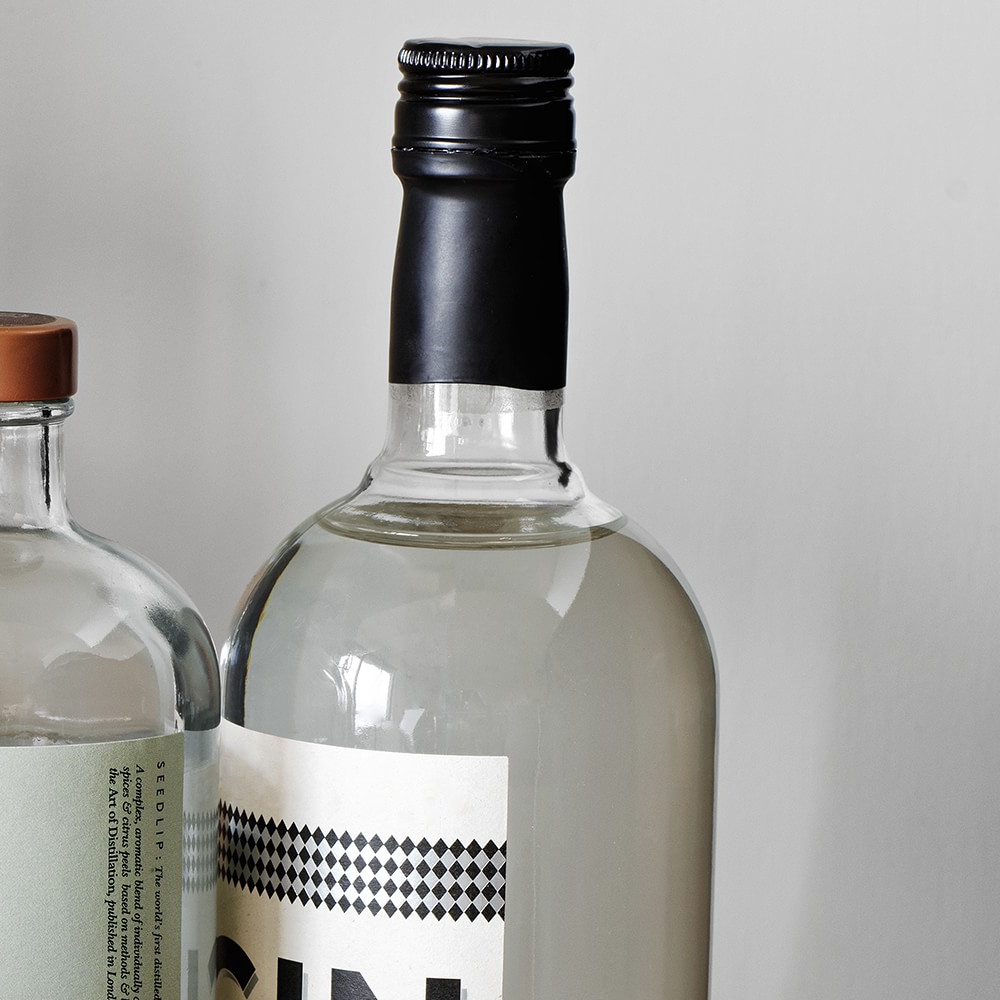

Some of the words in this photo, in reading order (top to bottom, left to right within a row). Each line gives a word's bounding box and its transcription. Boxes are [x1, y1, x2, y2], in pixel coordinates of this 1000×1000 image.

[109, 768, 118, 784] the
[120, 766, 131, 797] spices
[136, 765, 144, 773] A
[108, 788, 118, 808] Art
[122, 801, 131, 815] &
[133, 777, 144, 825] complex,
[108, 811, 118, 824] of
[122, 817, 131, 848] citrus
[106, 827, 118, 896] Distillation,
[119, 851, 131, 877] peels
[135, 828, 143, 877] aromatic
[155, 866, 163, 887] The
[121, 884, 130, 914] based
[134, 880, 143, 910] blend
[105, 900, 118, 952] published
[121, 918, 128, 931] on
[131, 913, 143, 924] of
[152, 932, 162, 954] first
[107, 956, 116, 967] in
[120, 935, 130, 979] methods
[131, 927, 142, 993] individually
[121, 983, 129, 996] &
[153, 958, 162, 1000] distilled
